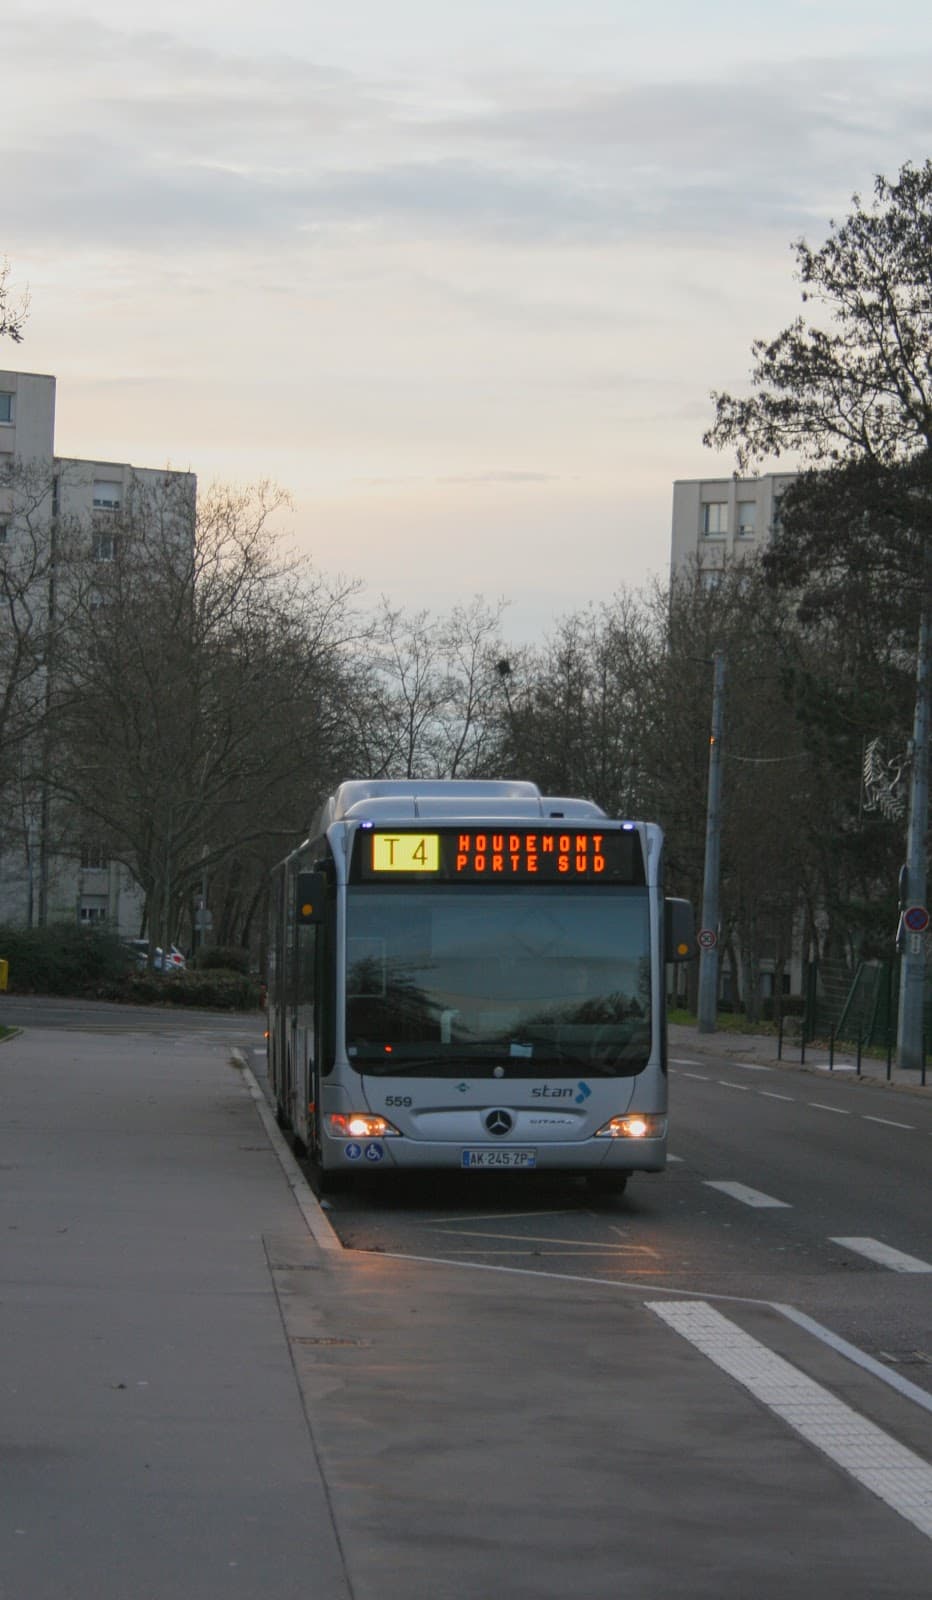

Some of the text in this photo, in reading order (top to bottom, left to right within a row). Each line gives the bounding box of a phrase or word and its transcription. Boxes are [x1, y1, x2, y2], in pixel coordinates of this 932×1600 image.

[411, 838, 428, 866] 4
[458, 835, 604, 853] HOUDEMONT
[456, 855, 605, 872] PORTE SUD
[531, 1085, 574, 1098] stan
[384, 1095, 413, 1108] 559
